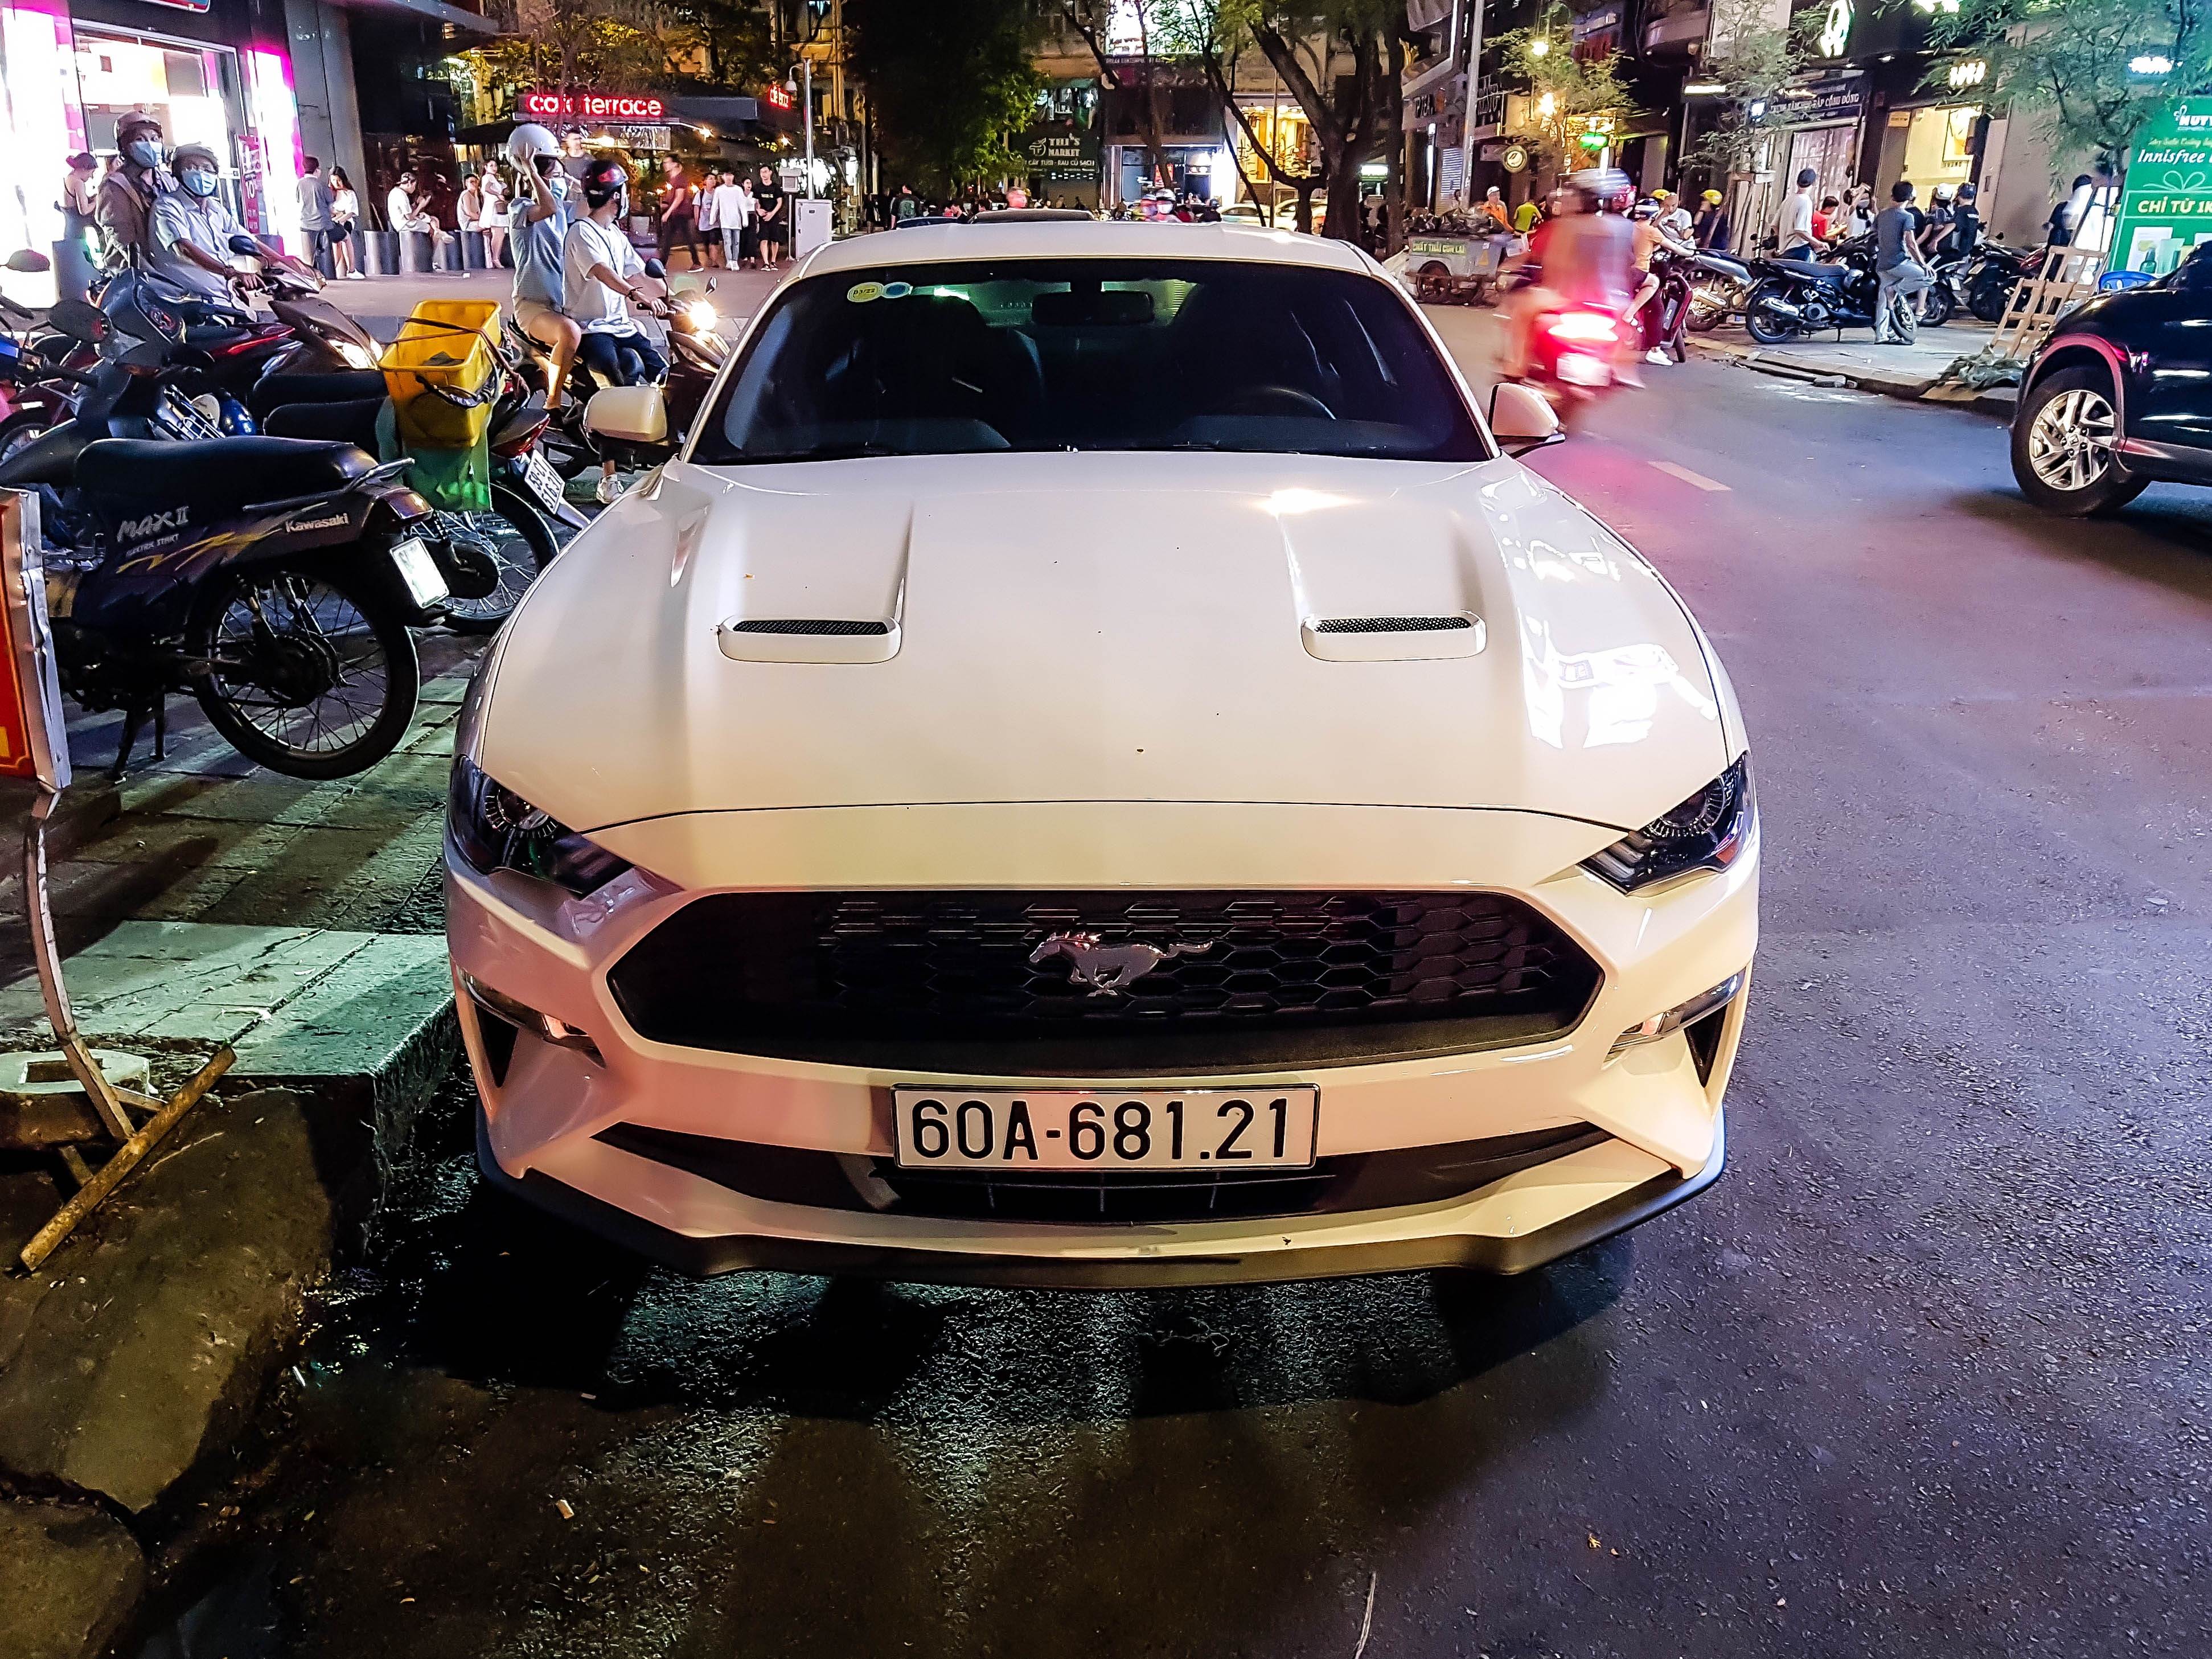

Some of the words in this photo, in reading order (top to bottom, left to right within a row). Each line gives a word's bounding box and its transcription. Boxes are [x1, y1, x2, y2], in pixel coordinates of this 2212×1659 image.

[584, 95, 662, 115] terrace
[2179, 115, 2212, 126] NUT
[1049, 148, 1080, 157] MARKET
[2137, 149, 2205, 165] Innisfree
[2137, 196, 2168, 213] CHỈ
[286, 513, 348, 532] Kawasaki
[912, 1098, 1288, 1161] 60A-681.21
